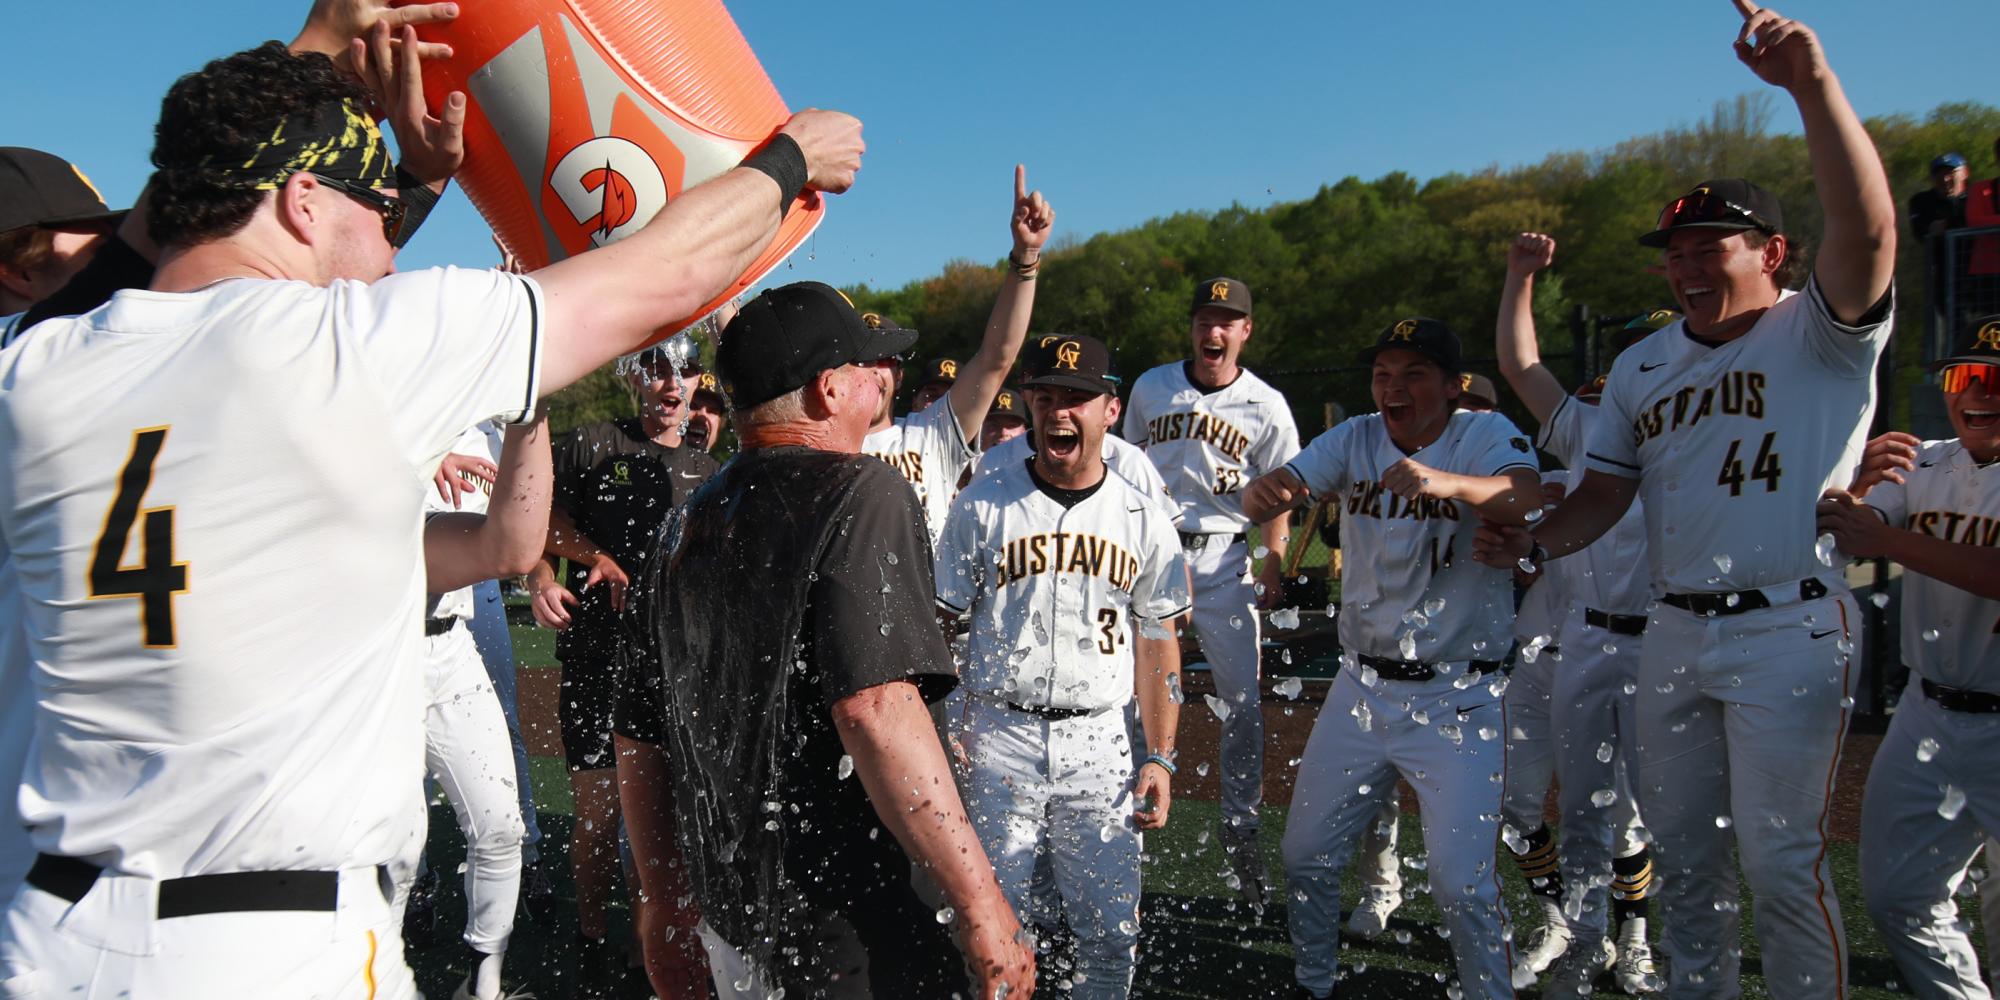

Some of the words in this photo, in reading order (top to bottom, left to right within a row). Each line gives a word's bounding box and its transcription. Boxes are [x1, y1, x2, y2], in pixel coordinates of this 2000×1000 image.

[1212, 466, 1241, 496] 32
[1717, 430, 1783, 497] 44
[84, 424, 192, 650] 4
[995, 531, 1139, 594] GUSTAVUS
[1096, 607, 1126, 656] 3
